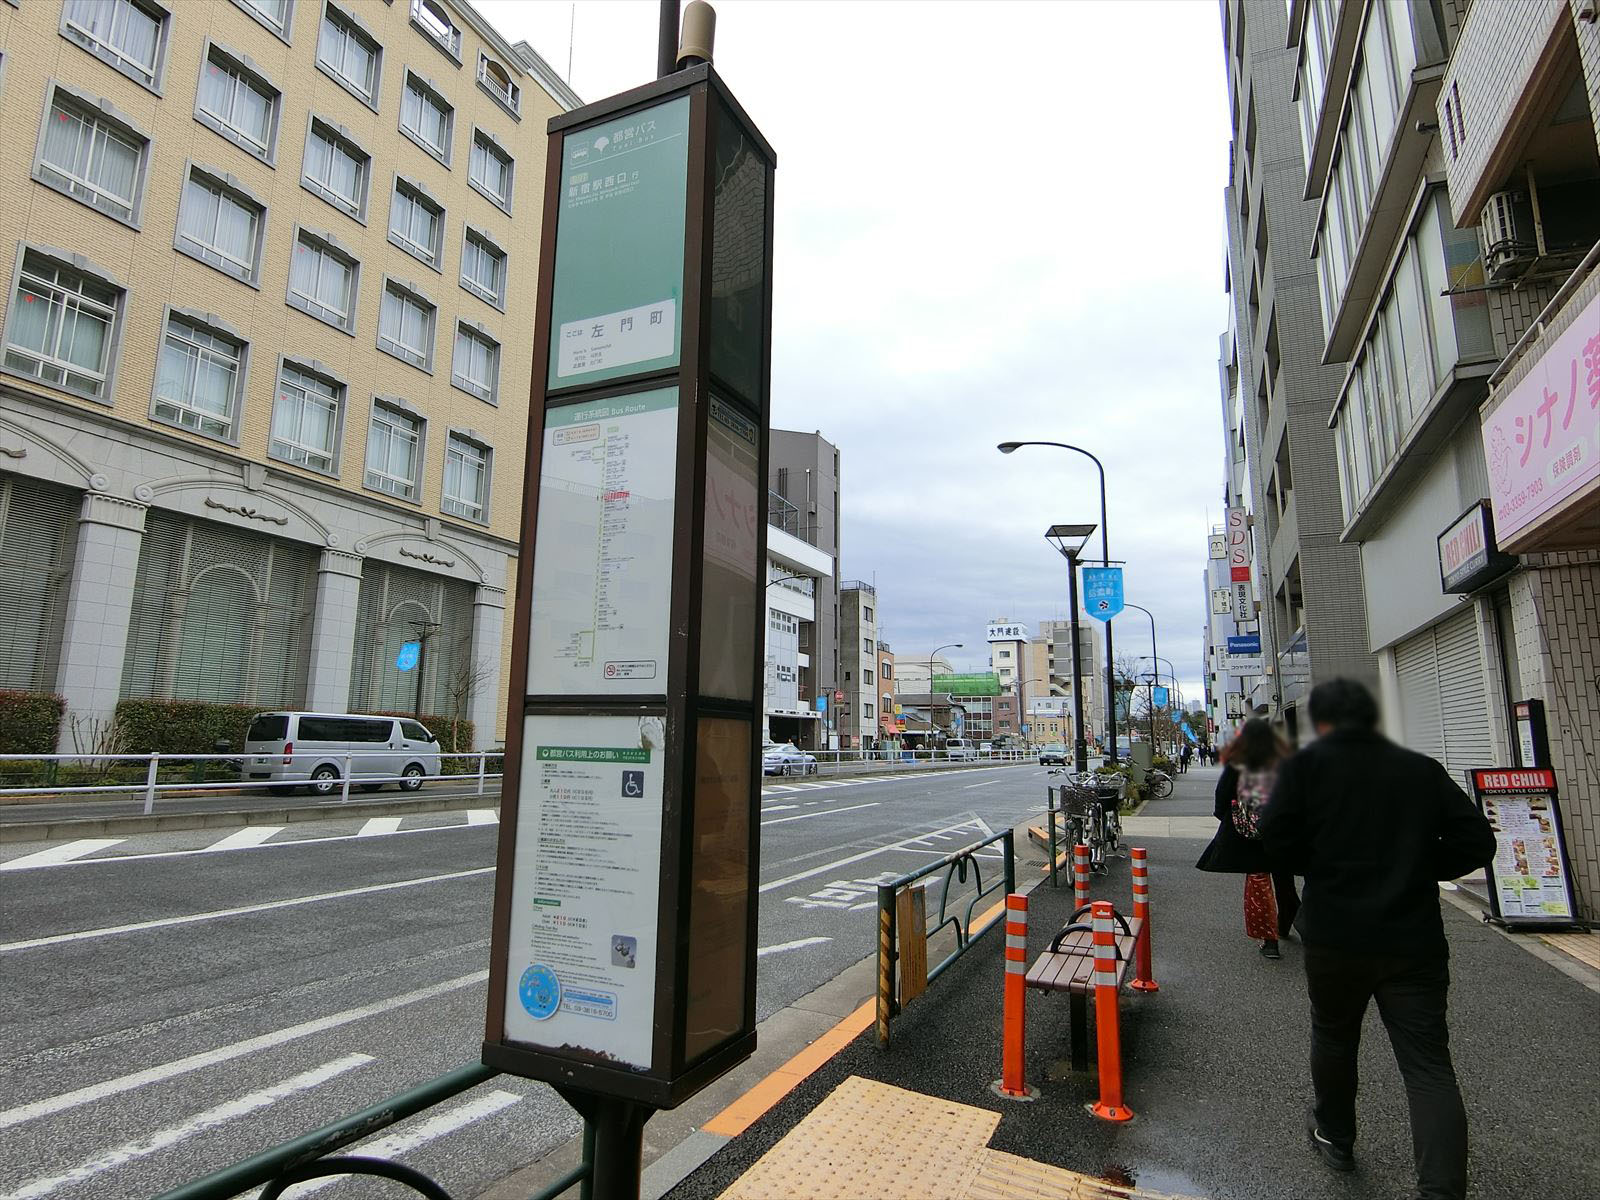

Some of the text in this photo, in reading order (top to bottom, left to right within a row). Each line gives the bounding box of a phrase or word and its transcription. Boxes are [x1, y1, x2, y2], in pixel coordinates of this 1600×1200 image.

[612, 120, 656, 144] 都営バス
[566, 310, 664, 339] ここは 左門町
[611, 407, 624, 416] Bus
[625, 404, 646, 413] Route
[1230, 511, 1246, 565] SDS
[1237, 584, 1248, 619] 表現文化社
[989, 626, 1020, 637] 大門建設
[1483, 773, 1546, 788] RED CHILI
